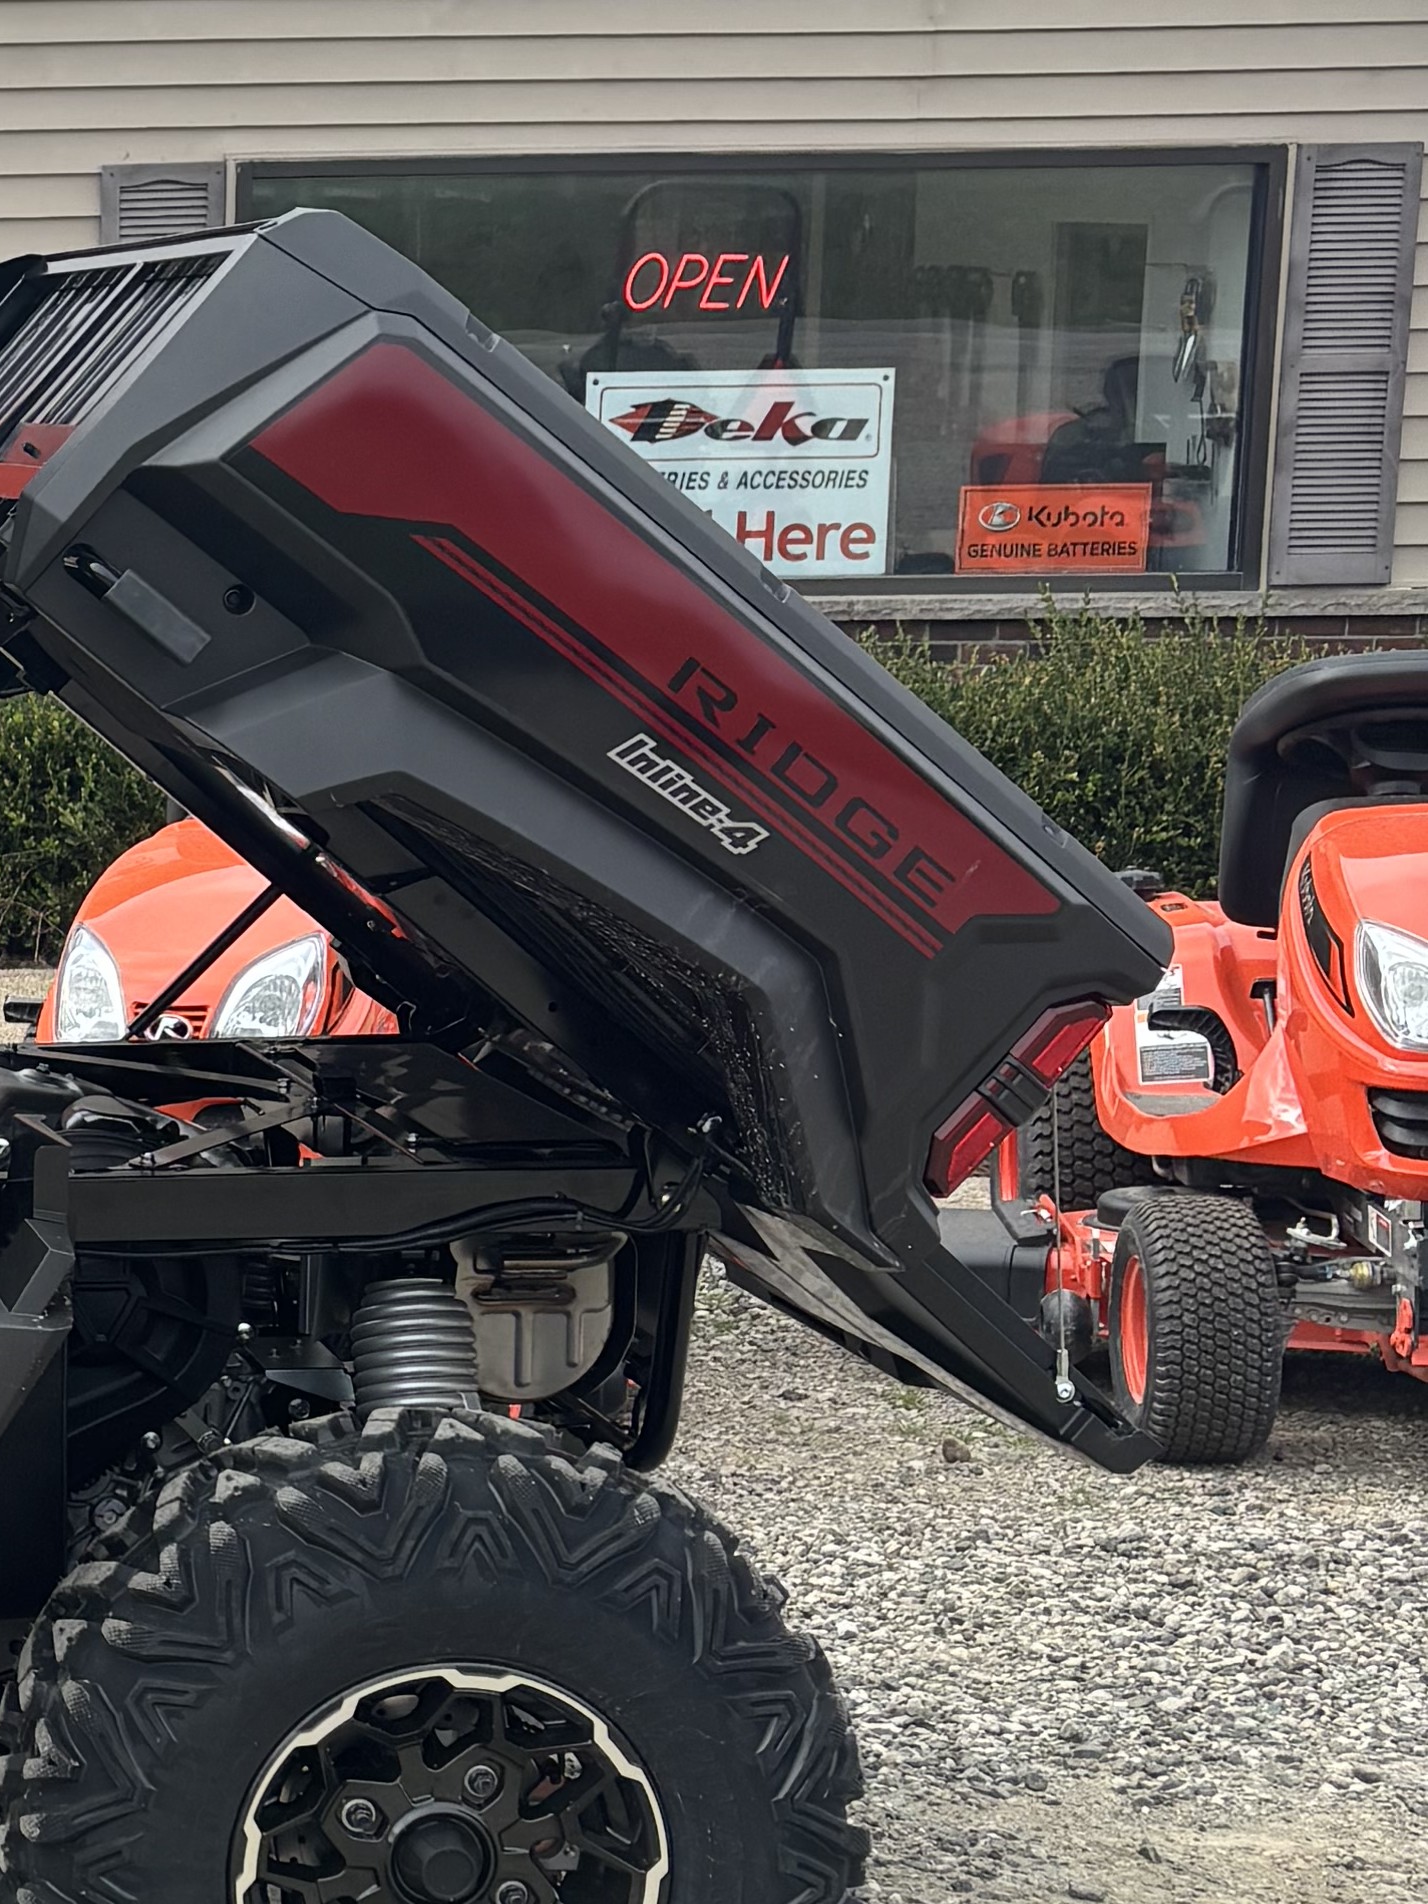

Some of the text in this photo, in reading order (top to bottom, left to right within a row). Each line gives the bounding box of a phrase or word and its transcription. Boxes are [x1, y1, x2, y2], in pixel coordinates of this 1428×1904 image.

[624, 252, 791, 312] OPEN
[609, 398, 870, 446] Deka
[717, 470, 729, 490] &
[736, 469, 870, 491] ACCESSORIES
[736, 510, 876, 562] Here
[1027, 505, 1126, 528] Kubota
[967, 540, 1138, 559] GENUINE BATTERIES
[606, 732, 771, 855] Inline-4
[667, 656, 957, 909] RIDGE
